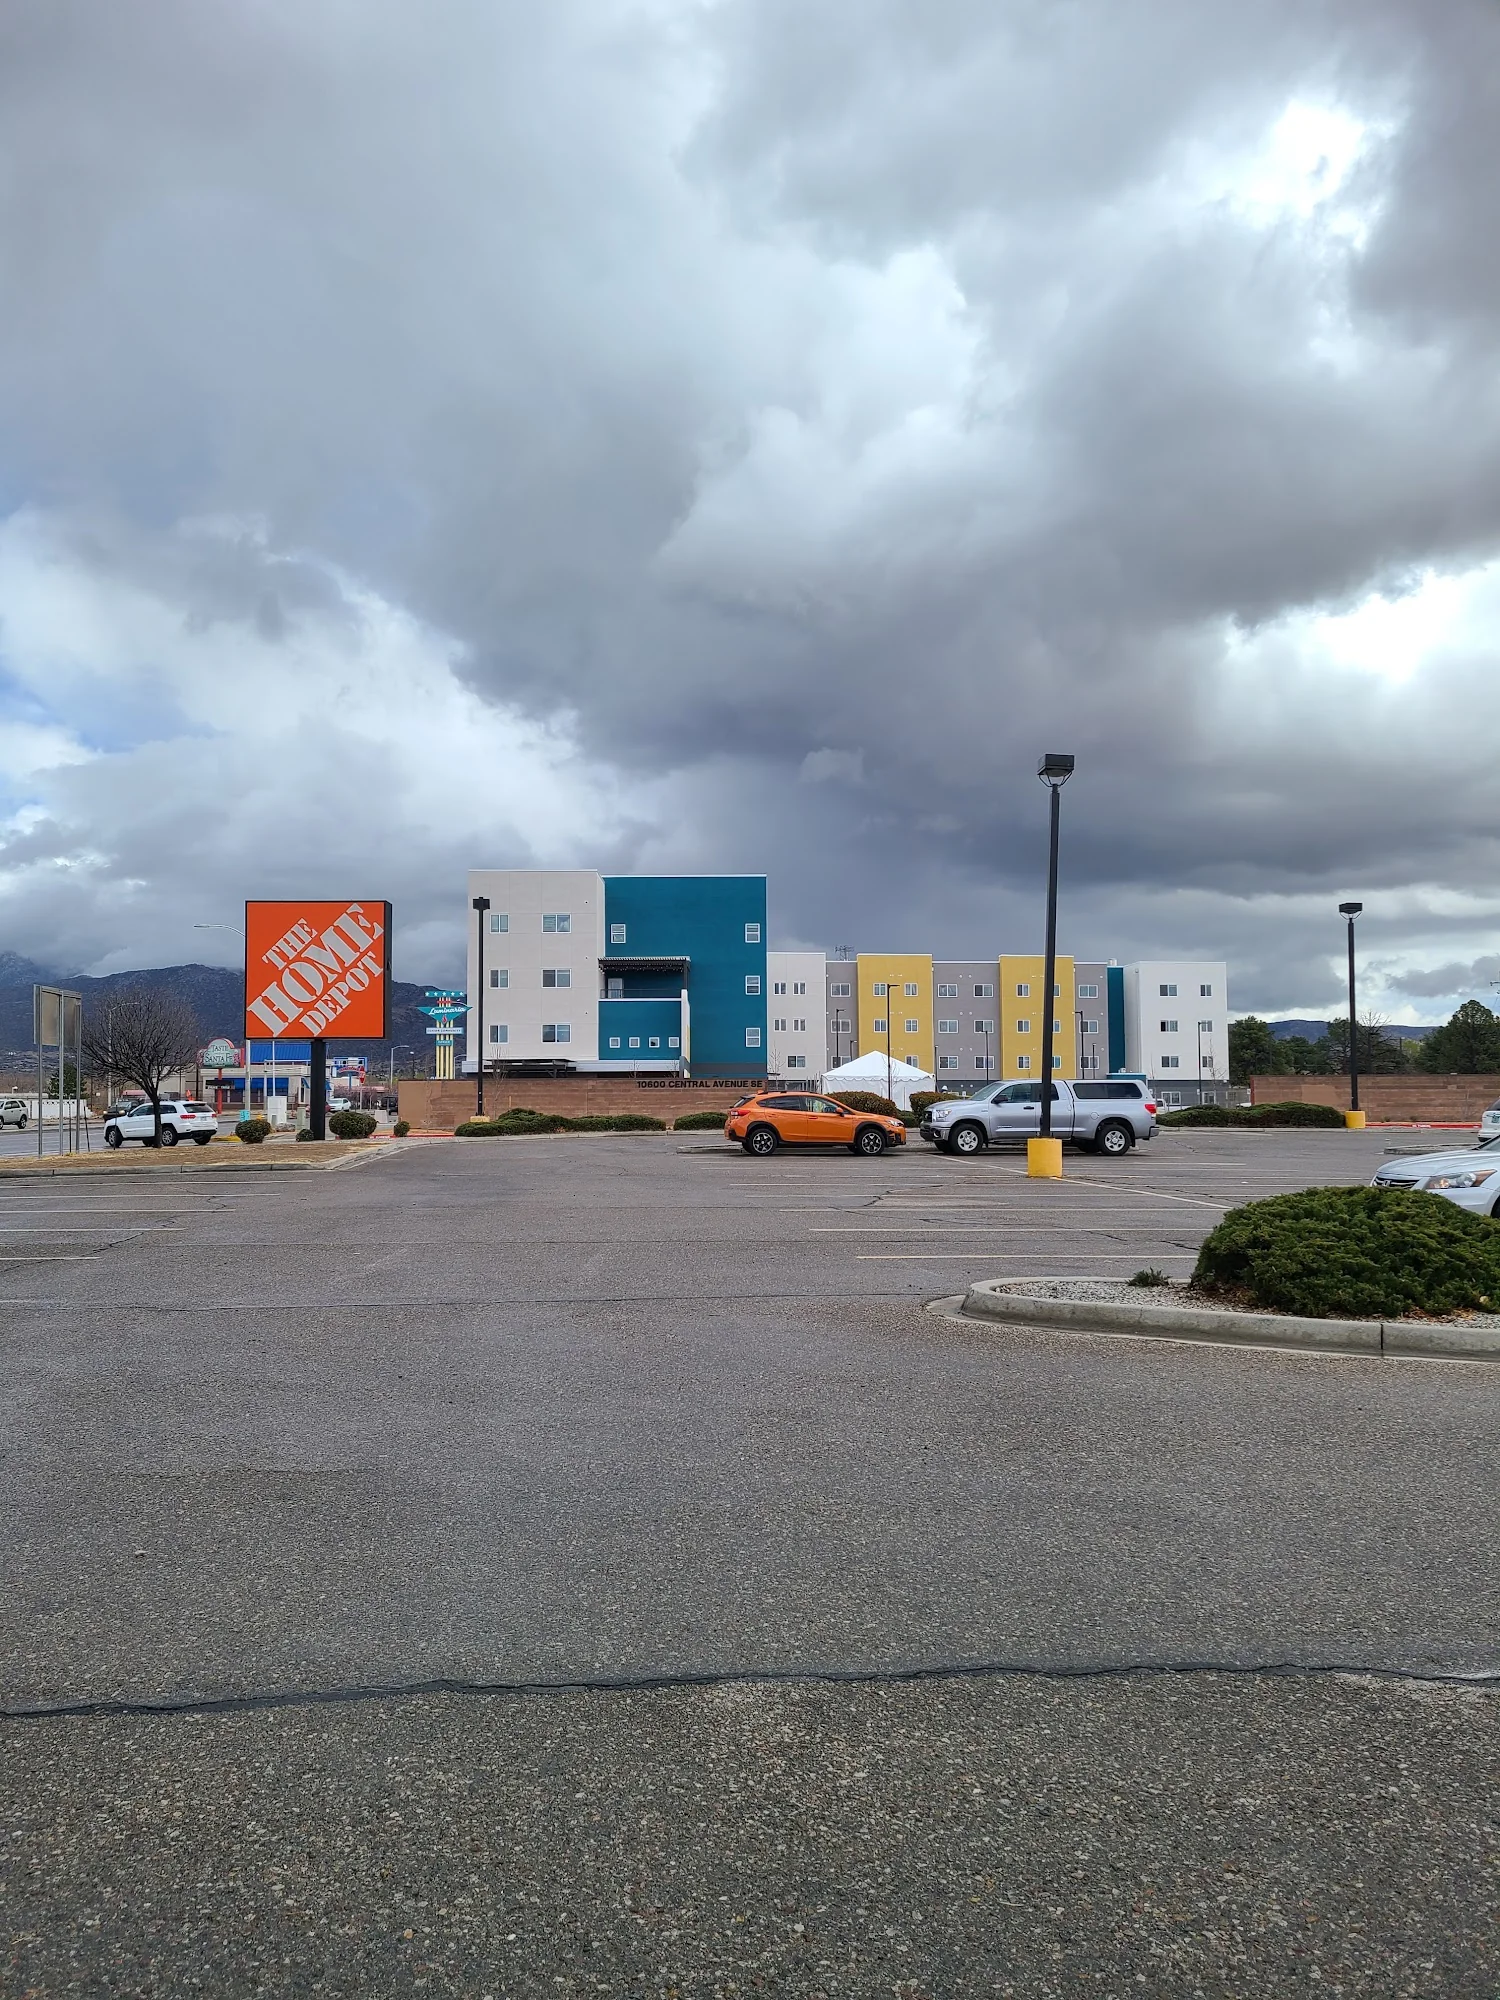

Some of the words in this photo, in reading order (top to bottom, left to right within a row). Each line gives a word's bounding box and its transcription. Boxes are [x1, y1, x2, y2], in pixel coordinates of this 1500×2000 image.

[246, 902, 384, 1038] HOME
[262, 917, 318, 971] THE
[299, 951, 384, 1037] DEPOT
[428, 1006, 466, 1015] Luminaria
[637, 1080, 665, 1089] 10600
[668, 1080, 710, 1088] CENTRAL
[712, 1080, 748, 1088] AVENUE
[750, 1080, 763, 1088] SE
